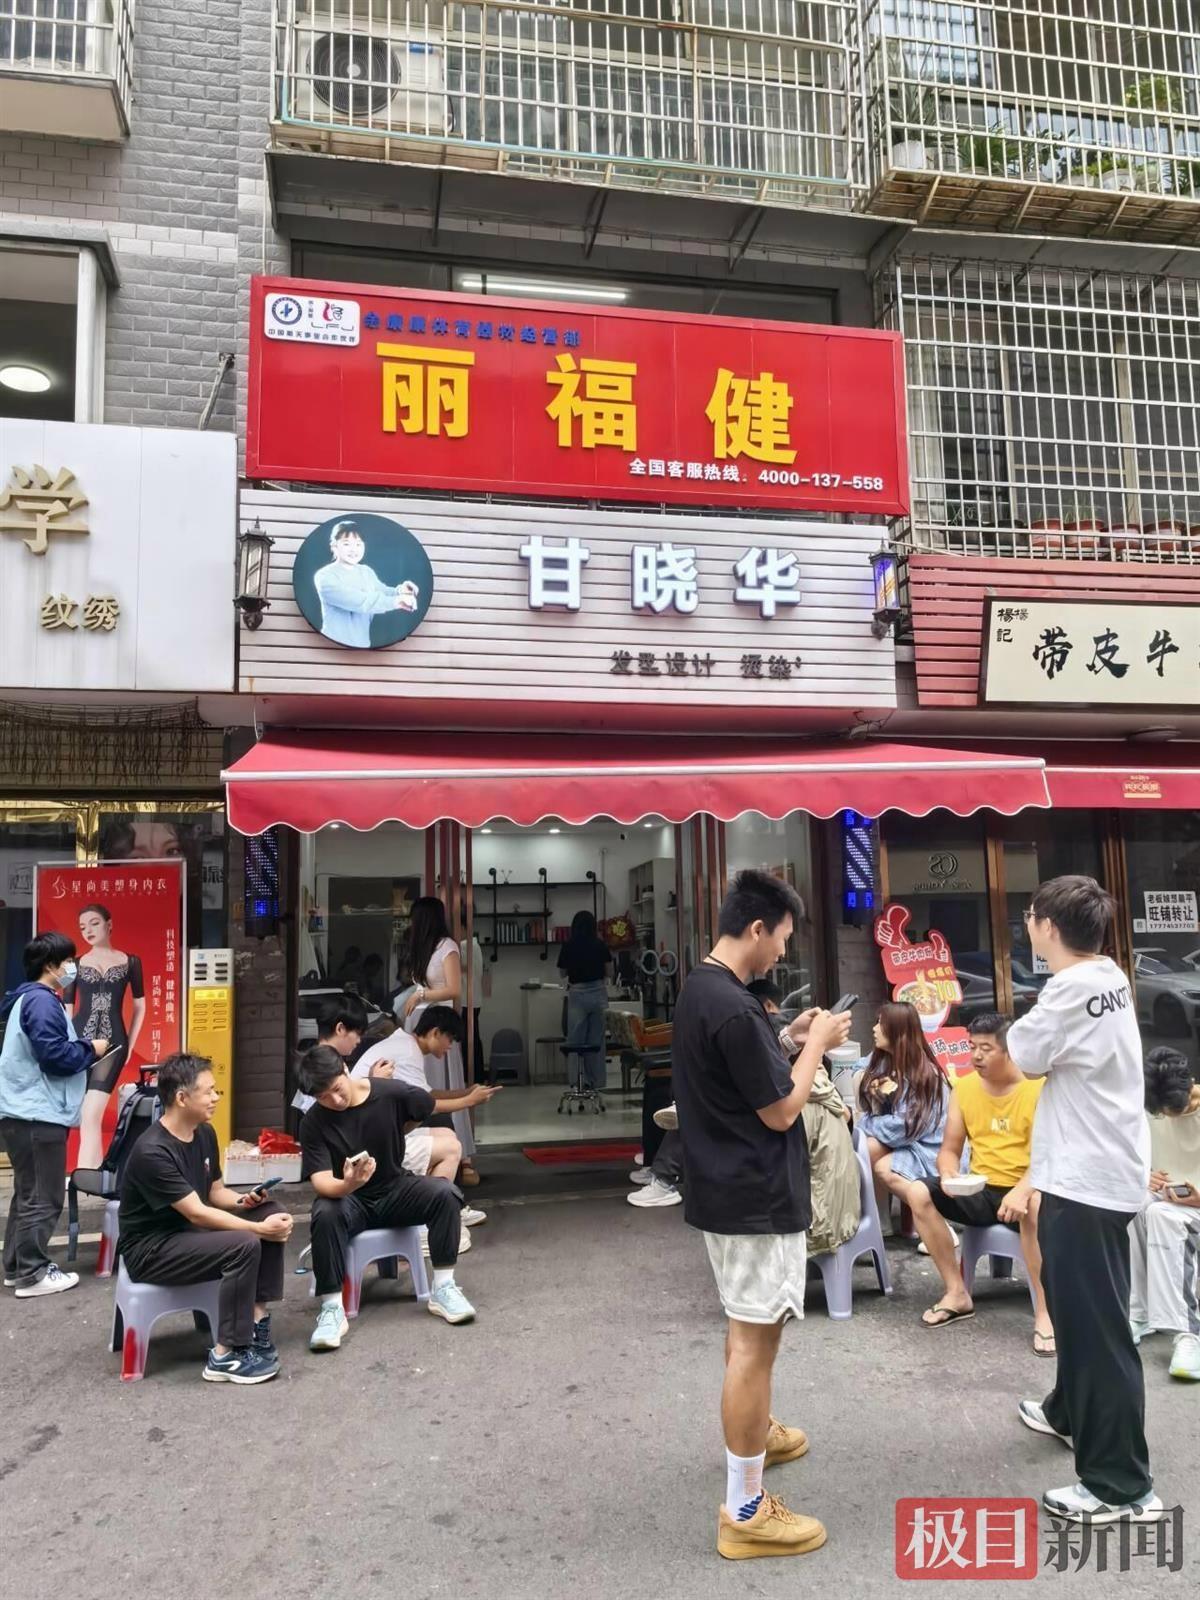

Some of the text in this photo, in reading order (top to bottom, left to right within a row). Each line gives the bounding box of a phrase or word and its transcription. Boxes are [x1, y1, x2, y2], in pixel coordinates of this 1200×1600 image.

[377, 342, 798, 464] 丽福健
[758, 469, 883, 491] 4000-137-558
[0, 464, 89, 555] 学
[519, 535, 801, 620] 甘晓华
[41, 593, 120, 631] 纹绣
[610, 650, 716, 677] 发型设计
[1032, 626, 1200, 680] 带皮牛
[72, 878, 167, 893] 星尚美塑身内衣
[1149, 905, 1194, 921] 旺铺转让
